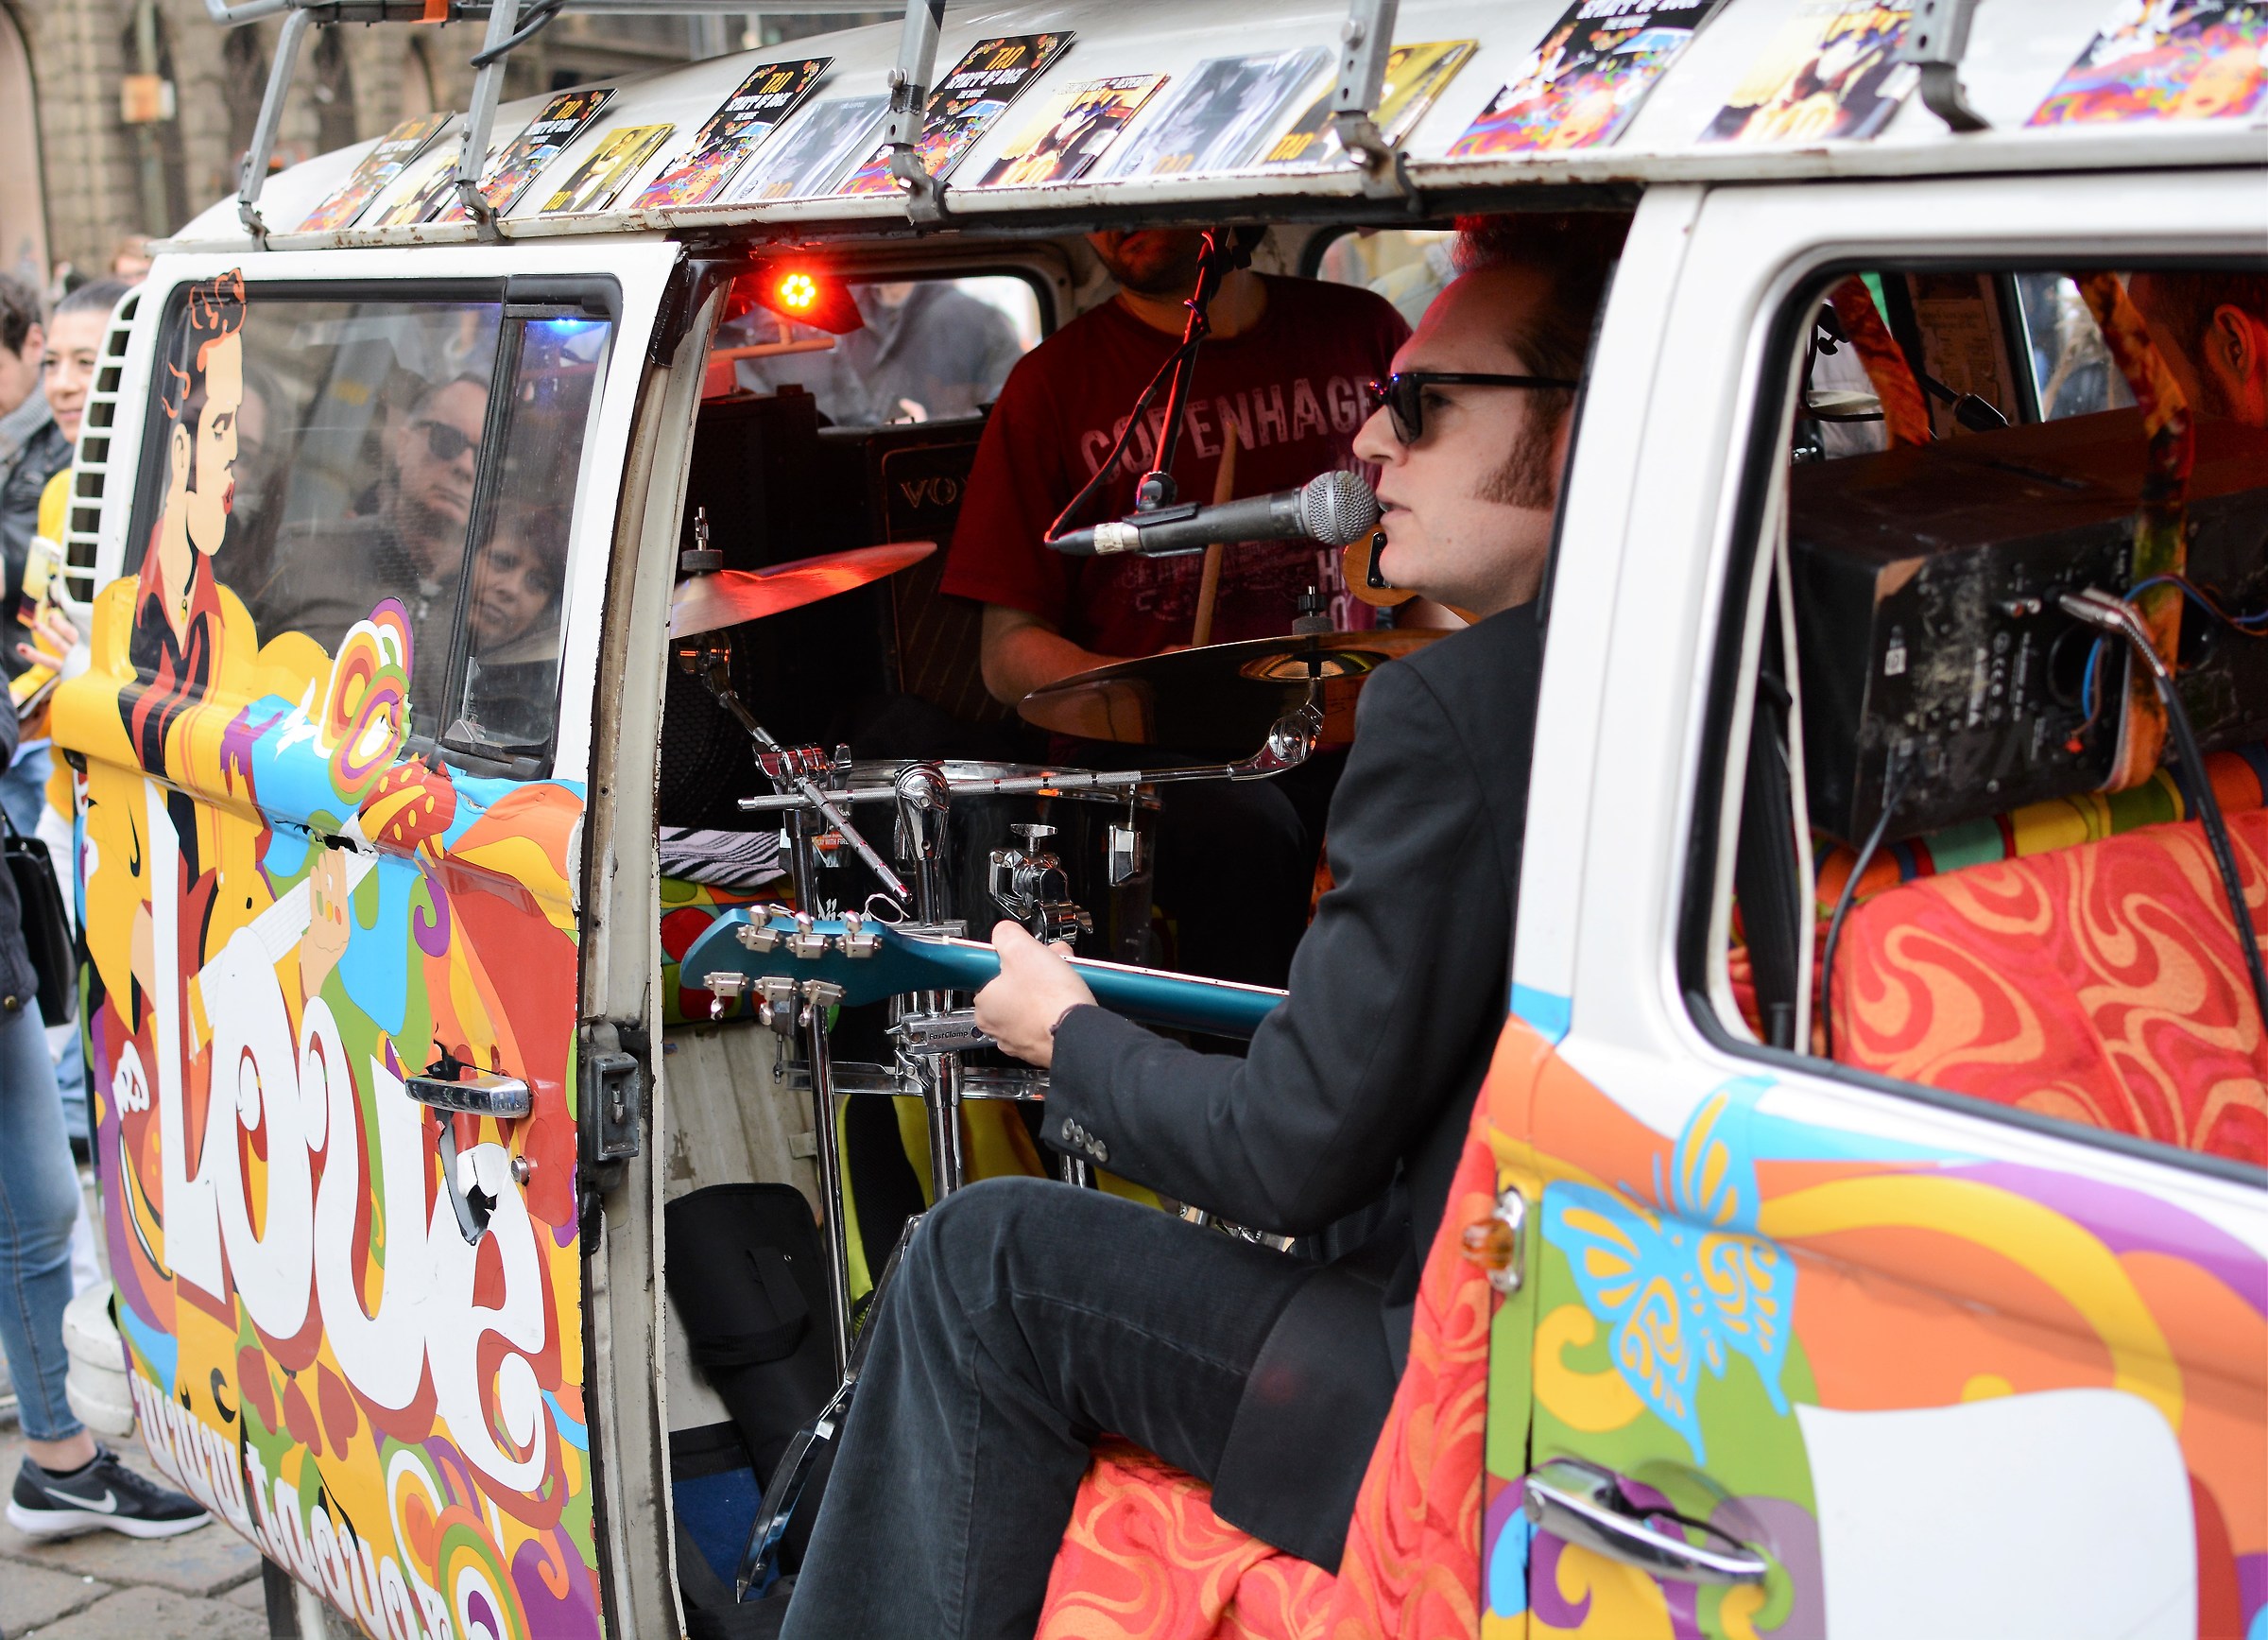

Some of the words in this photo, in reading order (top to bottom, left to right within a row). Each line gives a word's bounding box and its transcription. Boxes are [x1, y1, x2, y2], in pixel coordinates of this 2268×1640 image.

[985, 45, 1026, 71] TAO
[759, 71, 794, 95] TAO
[552, 99, 583, 121] TAO
[1267, 132, 1314, 162] TAO
[1002, 157, 1055, 185] TAO
[1152, 153, 1195, 175] TAO
[542, 190, 573, 211] TAO
[929, 1030, 970, 1041] FastClamp
